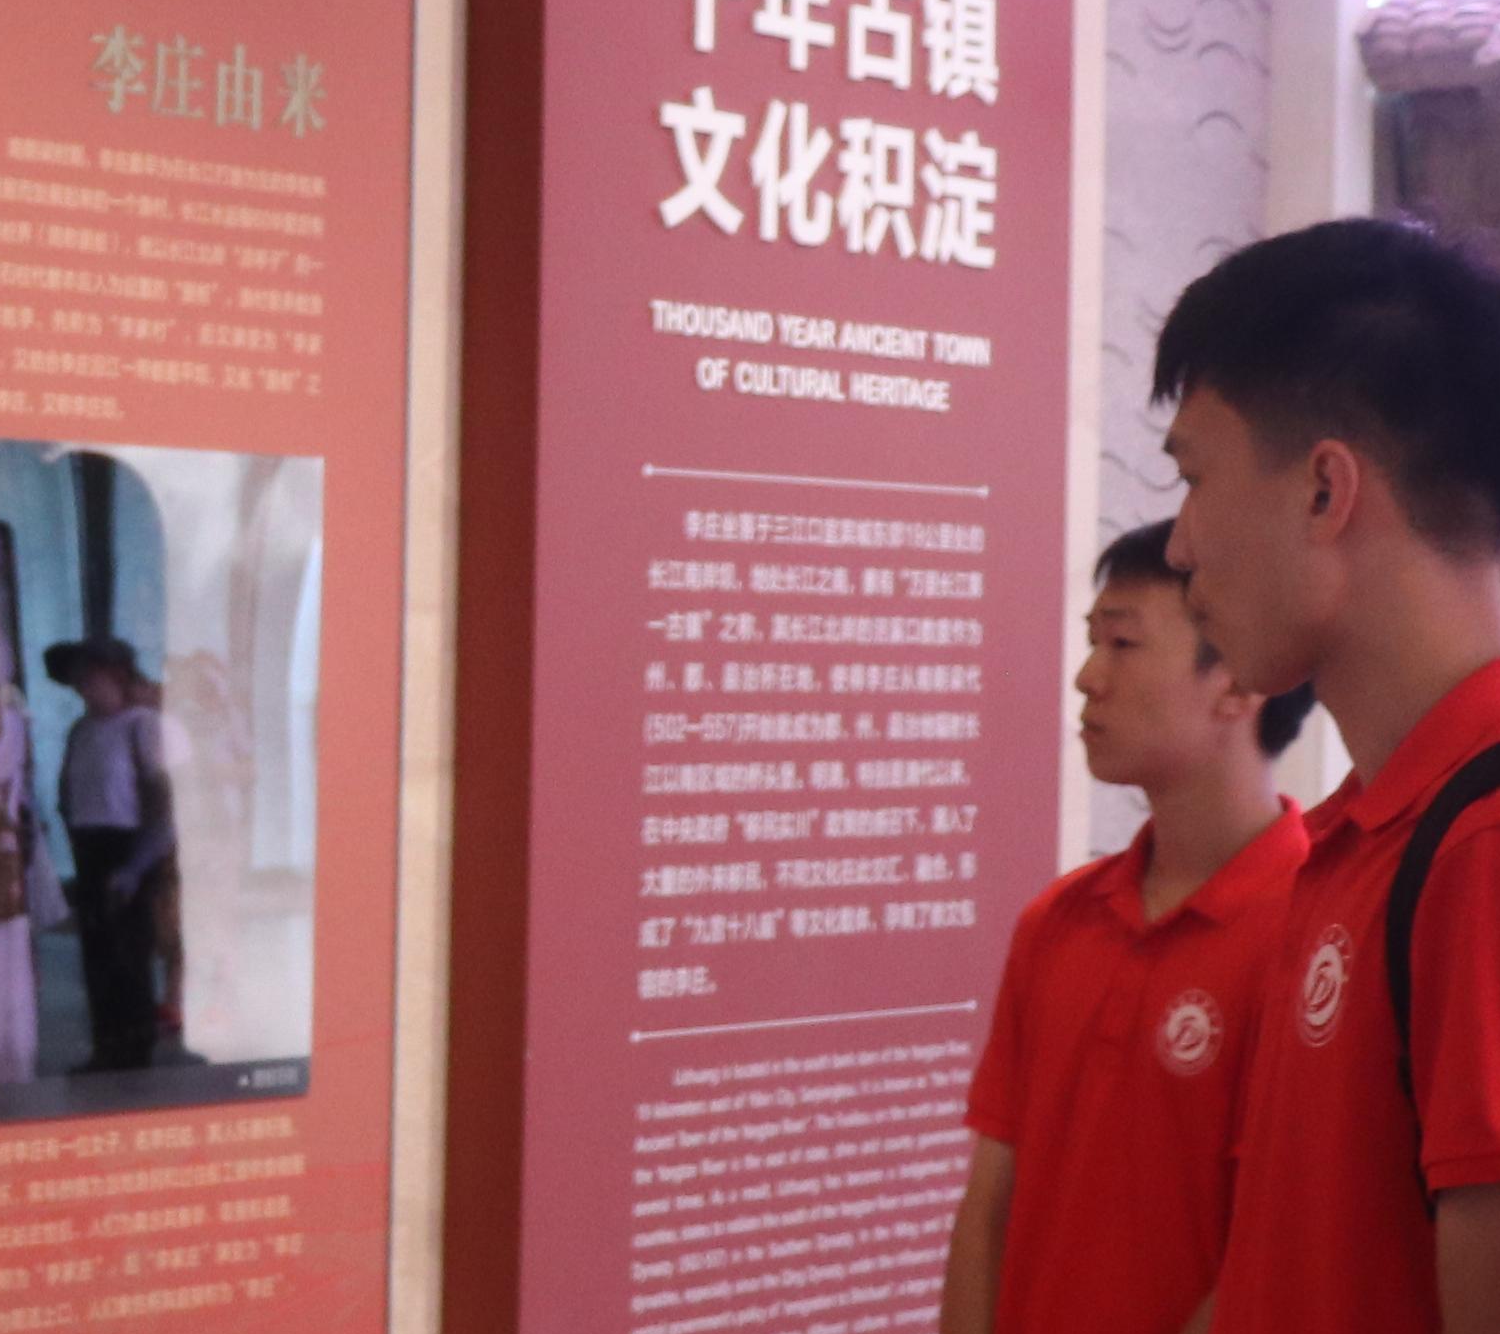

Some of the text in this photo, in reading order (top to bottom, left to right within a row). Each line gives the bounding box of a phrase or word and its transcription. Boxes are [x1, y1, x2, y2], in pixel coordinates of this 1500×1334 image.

[88, 24, 327, 139] 李庄由来
[657, 84, 999, 269] 文化积淀
[650, 299, 992, 367] THOUSAND YEAR ANCIENT TOWN
[695, 357, 951, 412] OF CULTURAL HERITAGE
